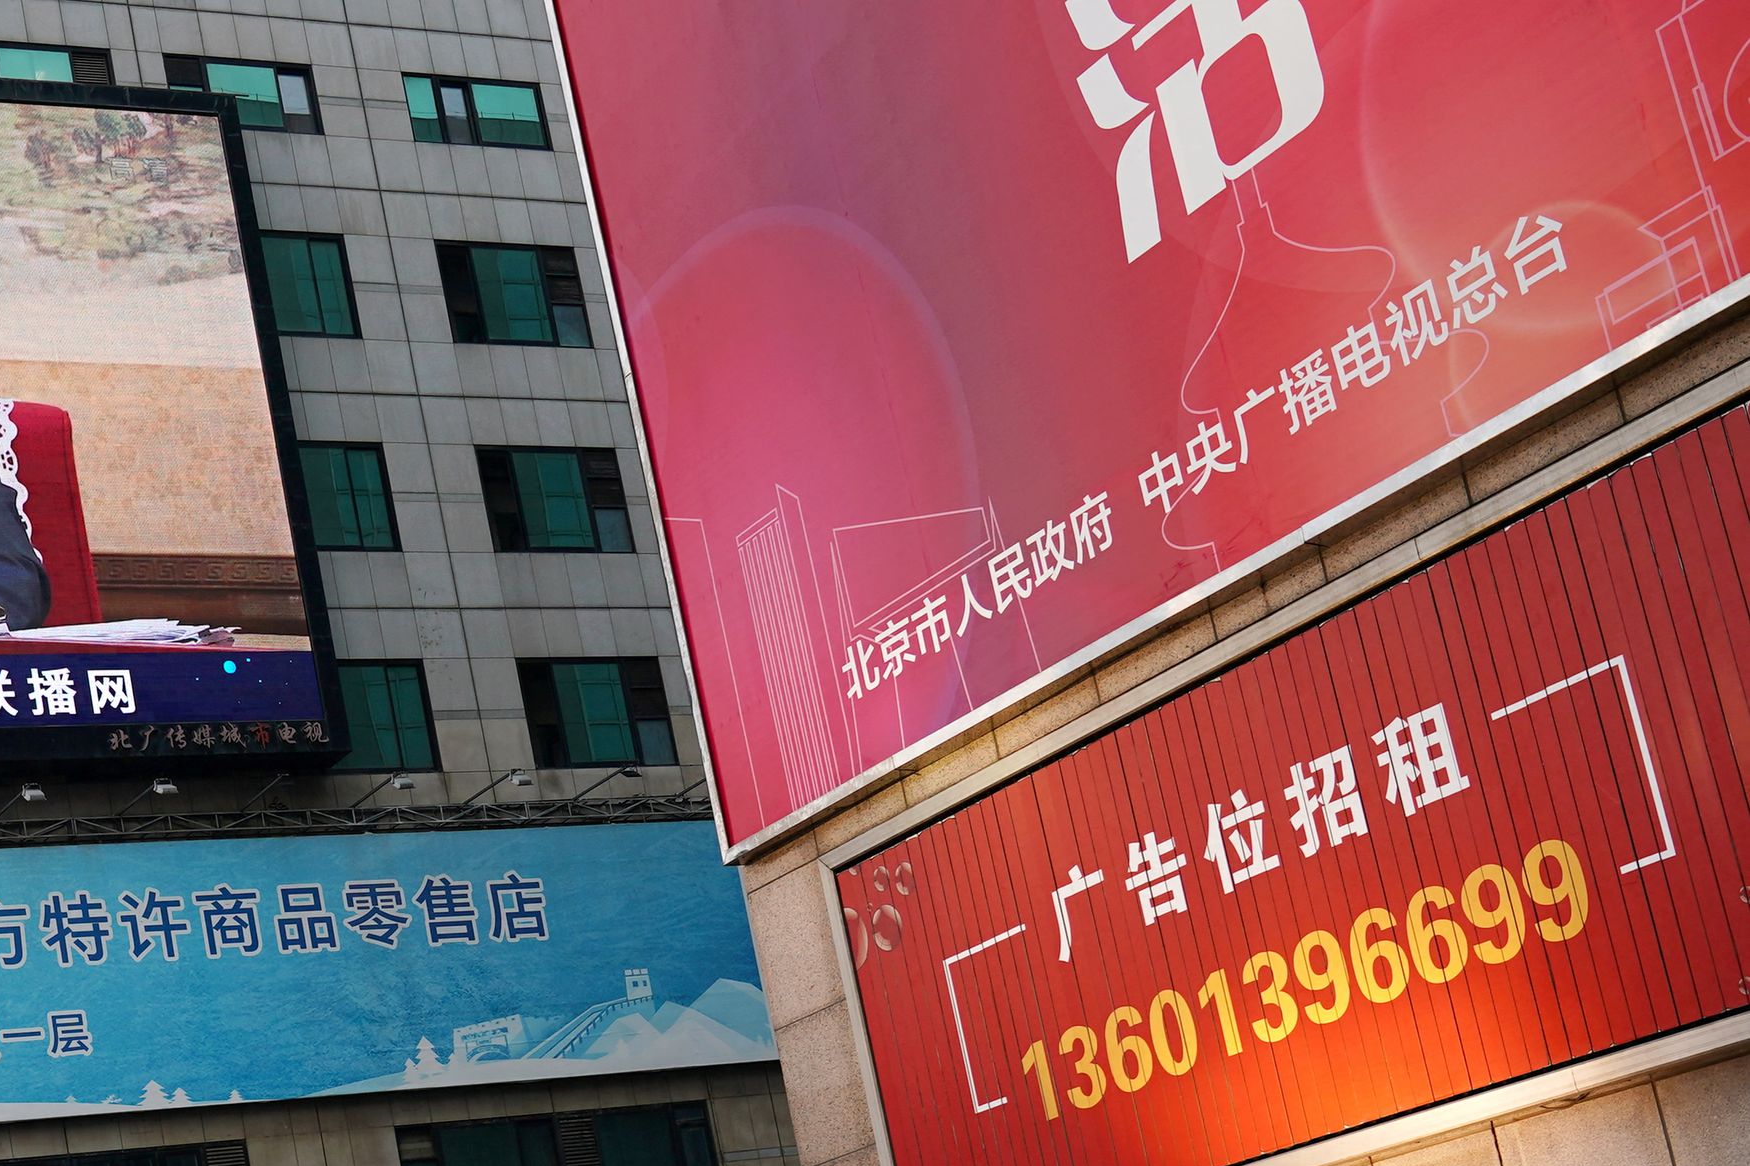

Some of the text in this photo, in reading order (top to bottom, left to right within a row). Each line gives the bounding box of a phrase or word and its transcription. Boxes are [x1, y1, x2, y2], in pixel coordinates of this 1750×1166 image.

[1137, 213, 1568, 515] 中央广播电视总台
[840, 491, 1115, 699] 北京市人民政府
[108, 721, 331, 751] 北广传媒城市电视
[1050, 702, 1470, 963] 广告位招租
[1020, 838, 1589, 1122] 13601396699
